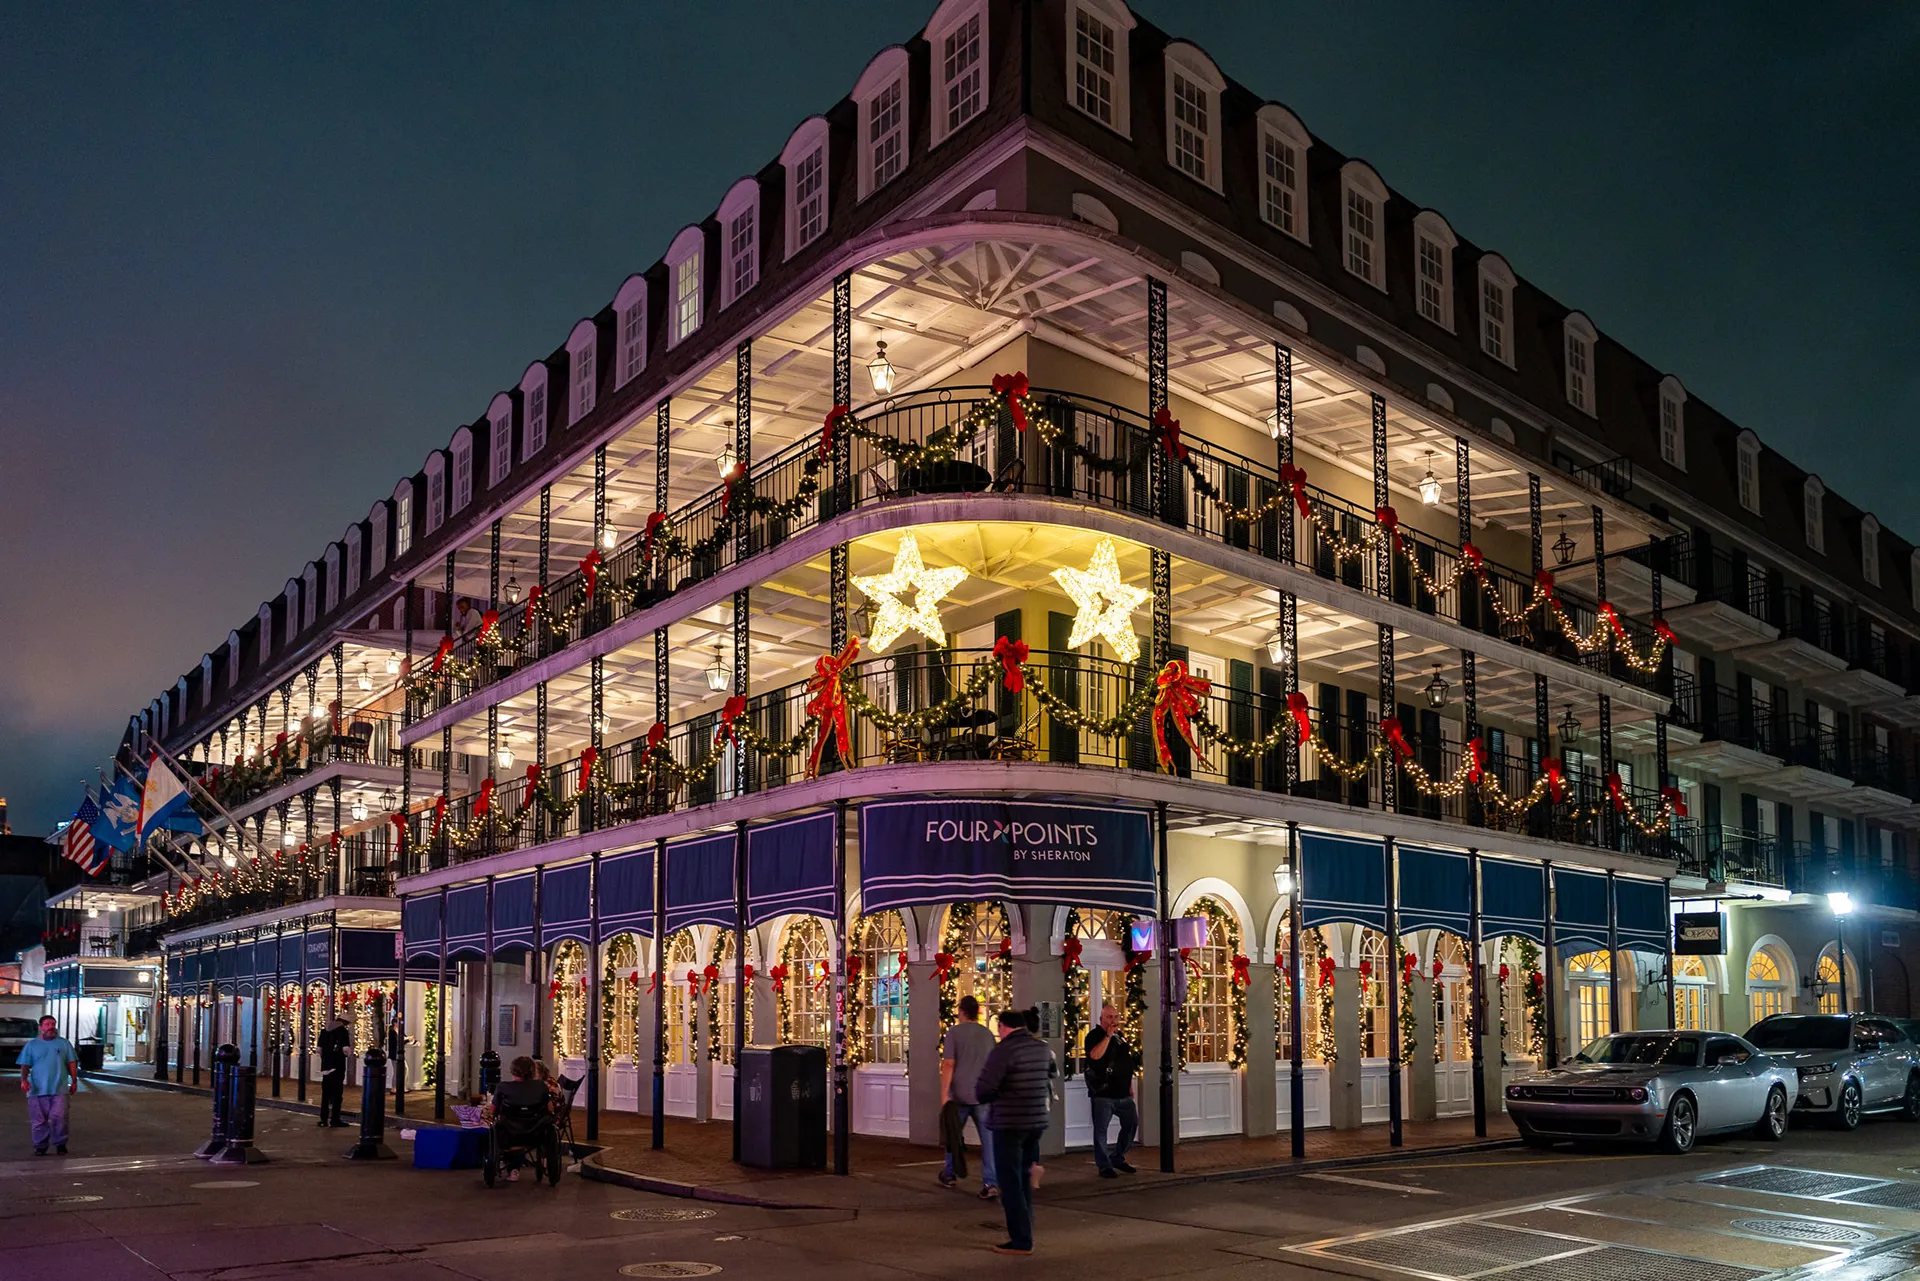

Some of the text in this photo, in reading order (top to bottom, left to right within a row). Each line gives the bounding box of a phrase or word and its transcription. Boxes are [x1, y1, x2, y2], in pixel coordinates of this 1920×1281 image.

[926, 820, 1098, 846] FOUR POINTS
[1014, 850, 1091, 861] BY SHERATON
